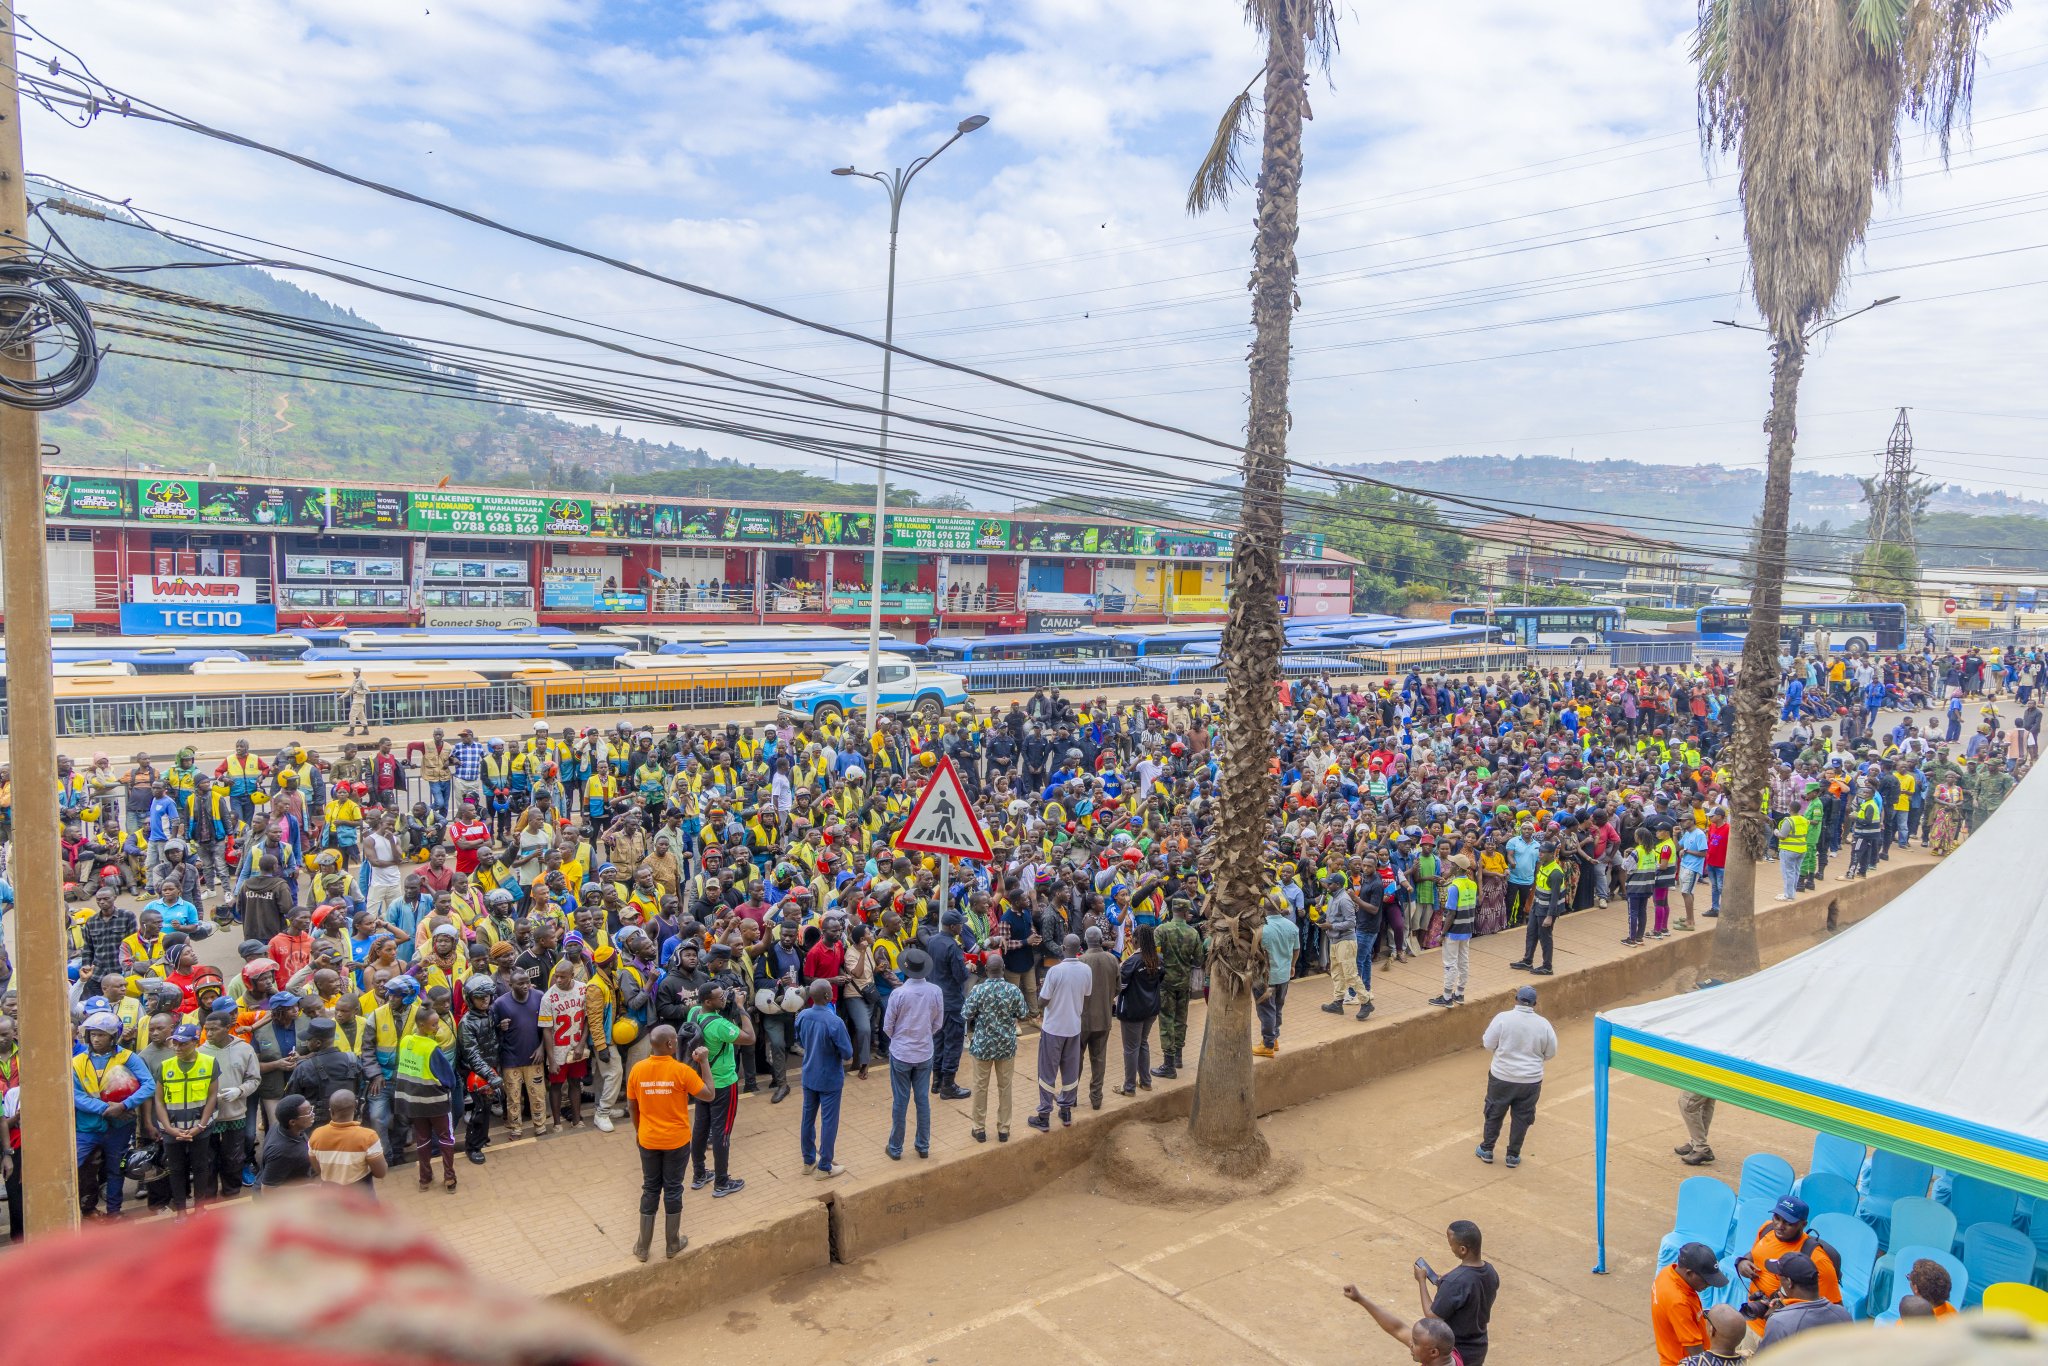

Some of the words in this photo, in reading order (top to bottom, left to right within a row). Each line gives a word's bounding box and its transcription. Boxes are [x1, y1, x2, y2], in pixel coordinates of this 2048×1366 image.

[436, 502, 474, 510] KOMANDO
[484, 498, 545, 506] KURANGURA
[142, 508, 196, 516] KOMANDO
[420, 510, 448, 520] TEL:
[452, 511, 482, 520] 0781
[486, 512, 510, 522] 696
[514, 514, 538, 523] 572
[452, 522, 485, 531] 0788
[489, 523, 512, 532] 688
[516, 524, 538, 533] 869
[546, 523, 588, 531] KOMANDO
[896, 530, 914, 538] TEL:
[916, 530, 935, 538] 0781
[916, 539, 936, 547] 0788
[938, 540, 954, 548] 688
[152, 577, 239, 596] WINNER
[160, 611, 242, 626] TECNO
[1040, 618, 1080, 628] CANAL+
[476, 620, 501, 628] Shop
[550, 993, 560, 1003] 23
[554, 1010, 586, 1046] 23
